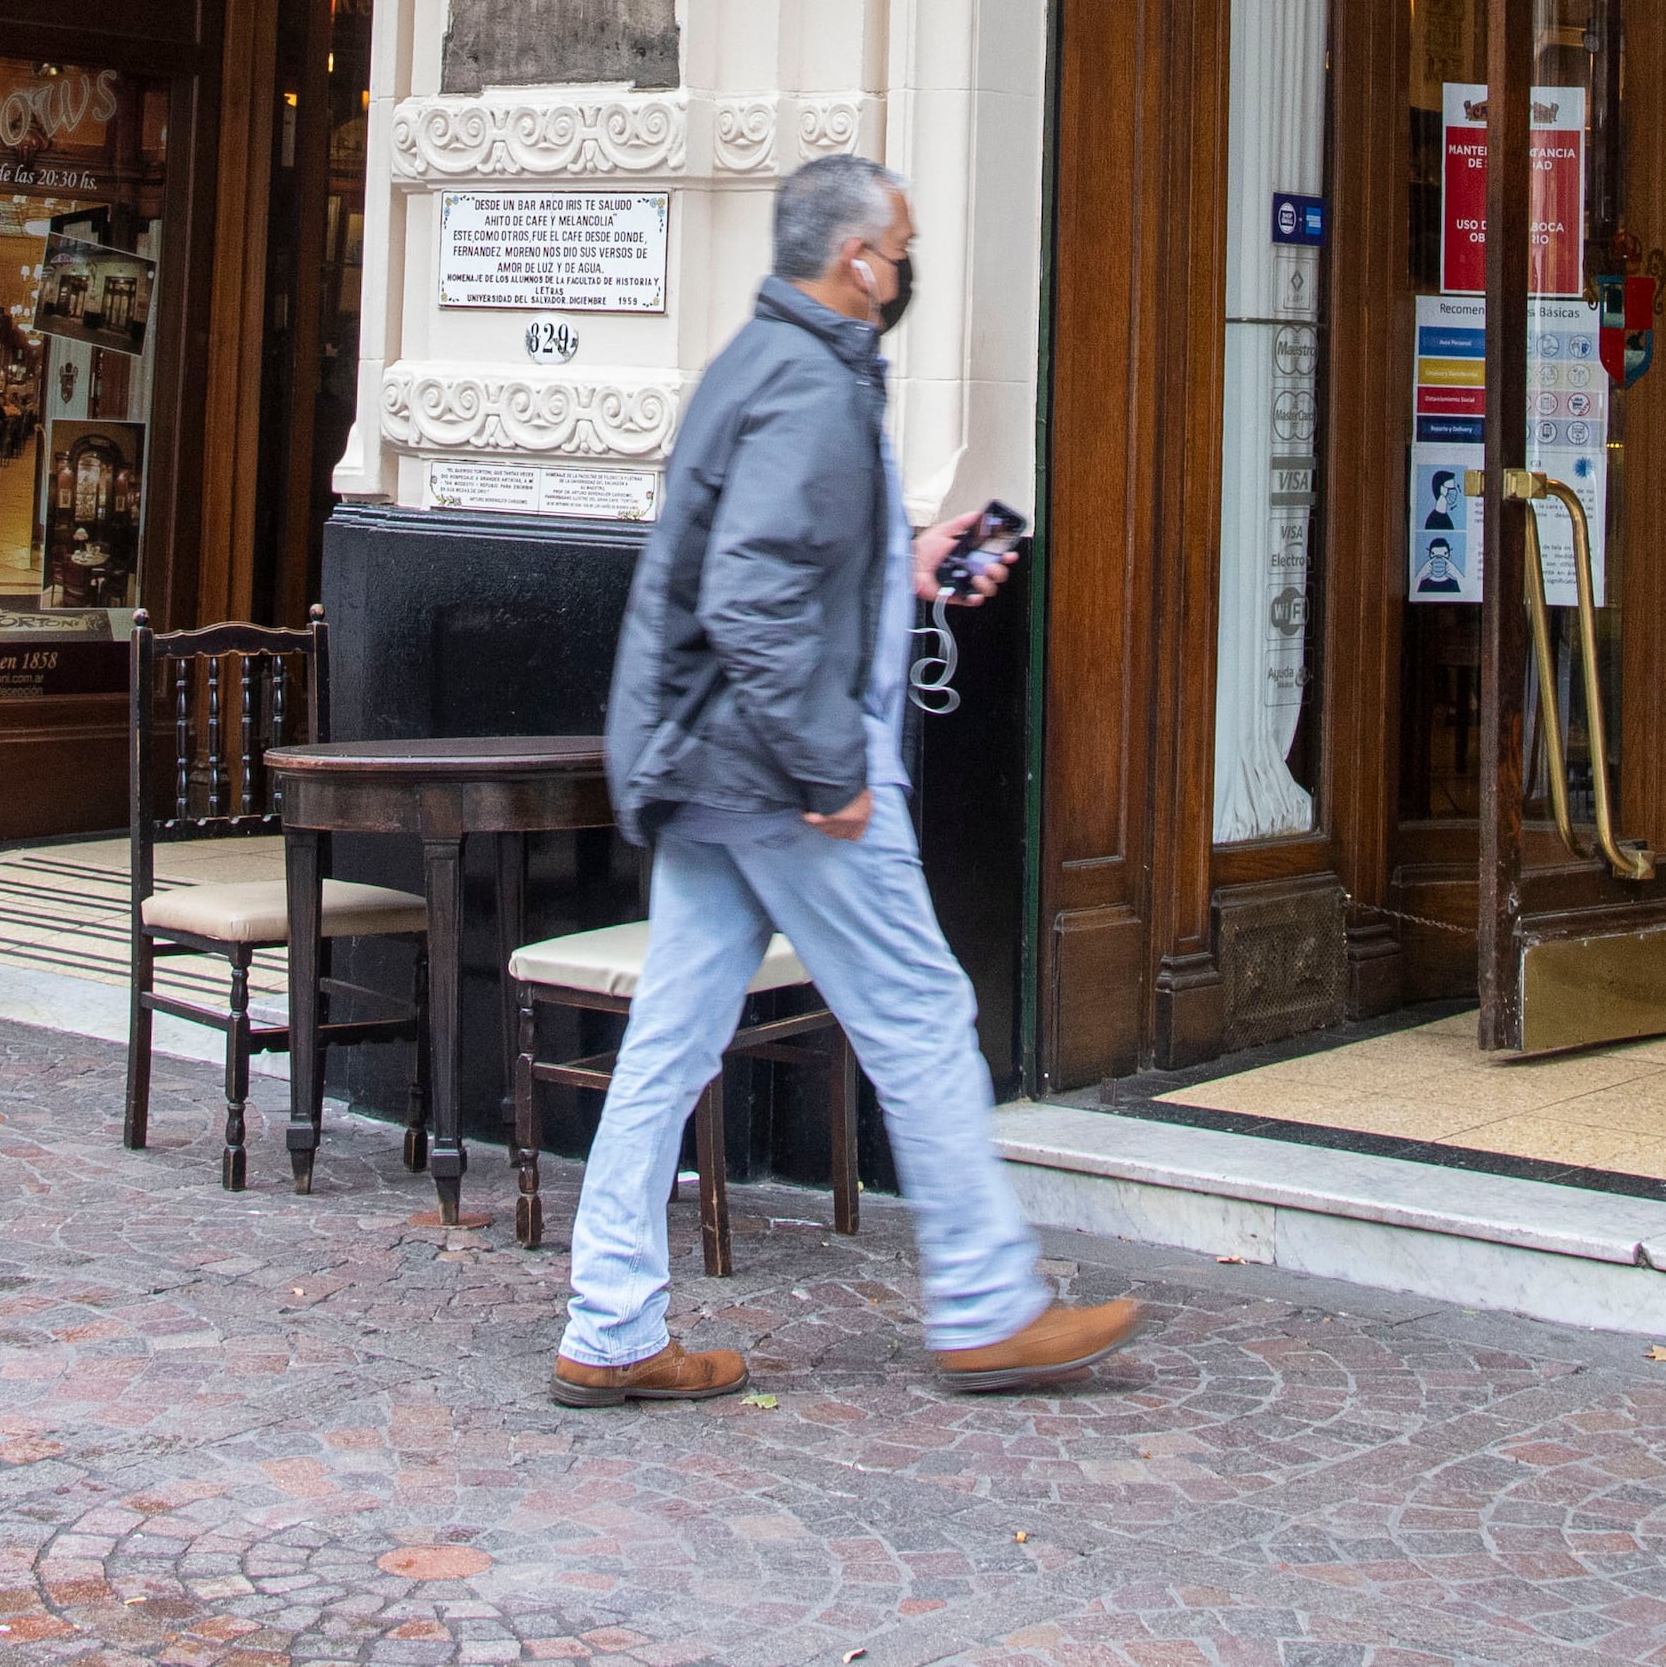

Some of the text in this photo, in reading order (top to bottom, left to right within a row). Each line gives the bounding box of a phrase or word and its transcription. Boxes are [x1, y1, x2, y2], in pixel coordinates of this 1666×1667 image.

[14, 165, 33, 184] las
[38, 169, 77, 188] 20:30
[80, 171, 98, 190] hs.
[503, 200, 631, 210] UN BAR ARCO IRIS TE SALUDO
[485, 215, 547, 226] AHITO DE CAFE
[1457, 220, 1478, 230] USO
[551, 231, 647, 244] EL CAFE DESDE DONDE,
[453, 247, 647, 259] FERNANDEZ MORENO NOS DIO SUS VERSOS DE
[497, 263, 604, 273] AMOR DE LUZ DE AGUA.
[448, 274, 651, 286] HOMENAJE LOS ALUMNOS FACULTAD HISTORIA
[535, 287, 564, 295] LETRAS
[467, 294, 512, 303] UNIVERSIDAD
[570, 296, 606, 305] DICIEMBRE
[1540, 307, 1580, 318] Básicas
[530, 323, 568, 354] 829
[1278, 342, 1316, 356] Maestro
[1276, 409, 1315, 421] MasterCard
[1279, 472, 1309, 490] VISA
[1281, 526, 1303, 539] VISA
[1272, 554, 1311, 567] Electron
[0, 656, 16, 669] en
[23, 652, 58, 669] 1858
[1268, 666, 1294, 682] Ayuda
